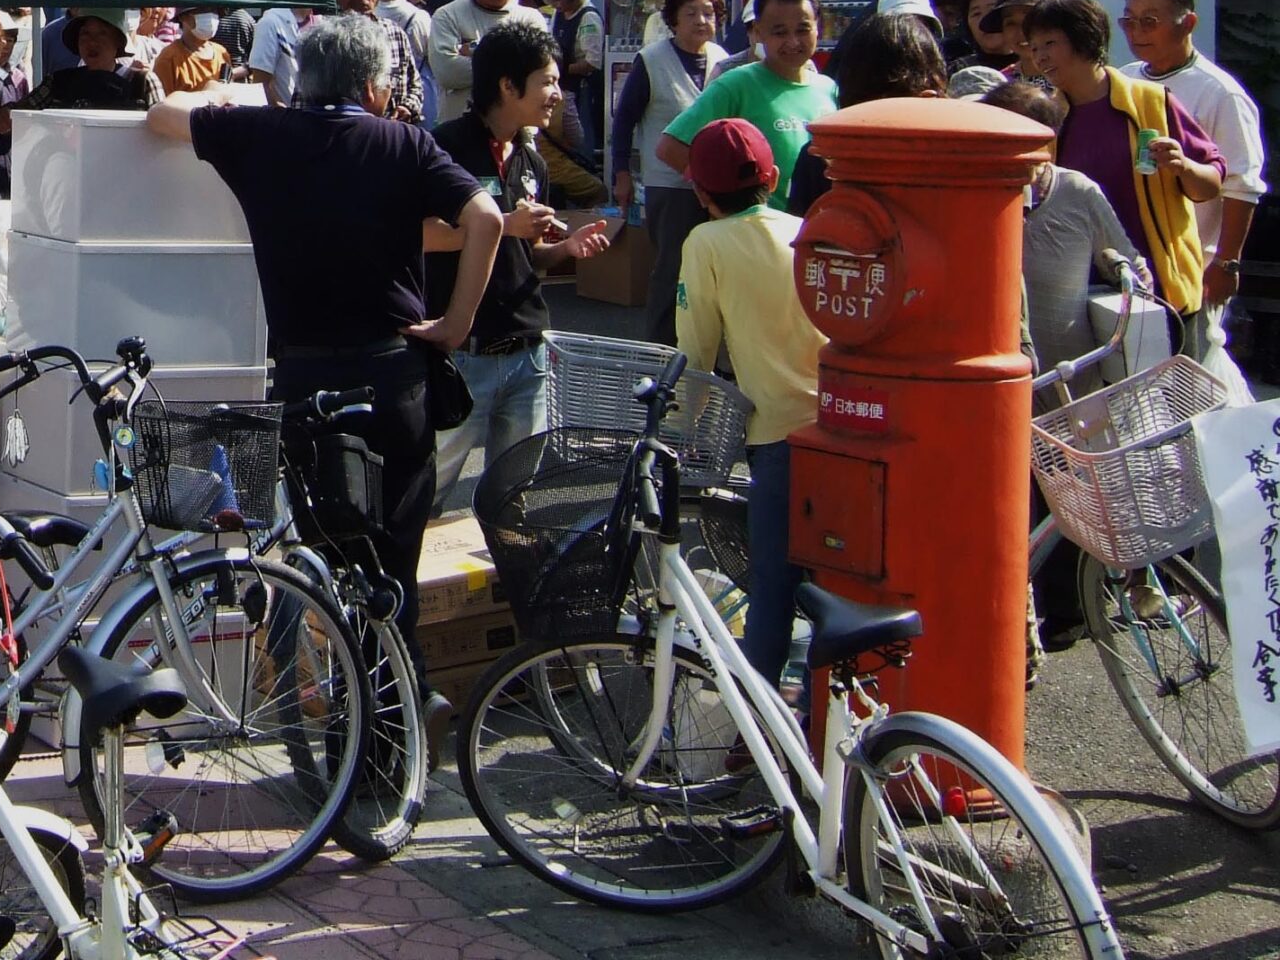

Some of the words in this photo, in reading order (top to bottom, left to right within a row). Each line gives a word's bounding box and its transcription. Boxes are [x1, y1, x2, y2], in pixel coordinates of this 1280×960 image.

[815, 292, 874, 319] POST
[835, 398, 884, 420] 日本郵便
